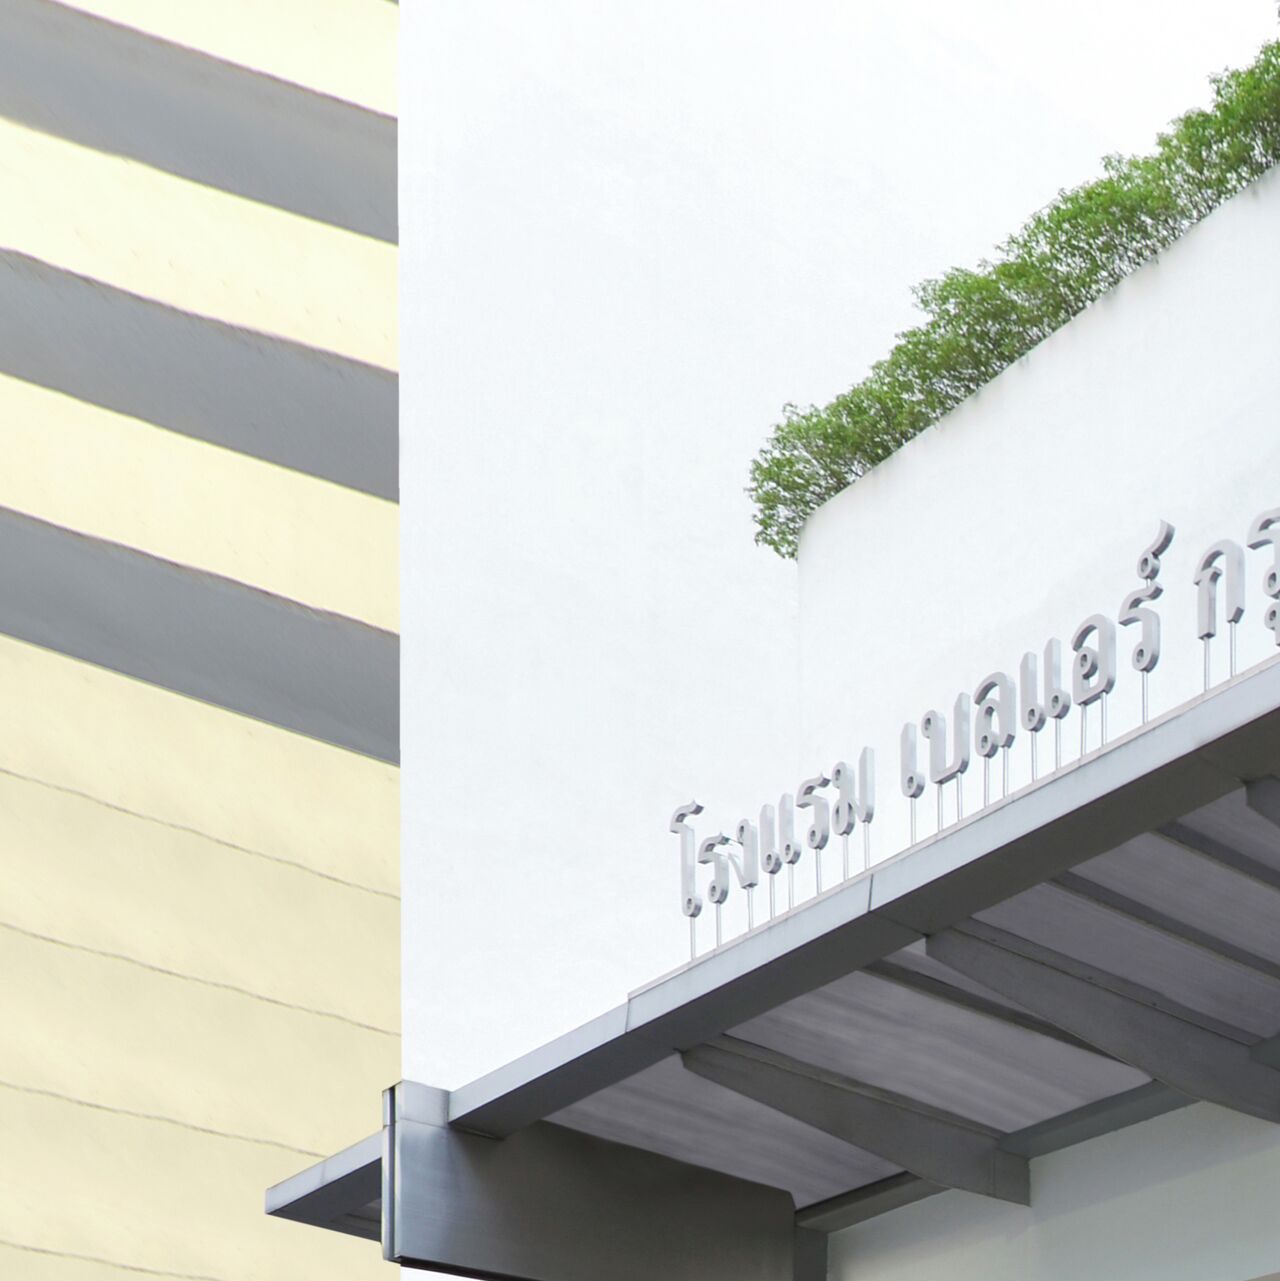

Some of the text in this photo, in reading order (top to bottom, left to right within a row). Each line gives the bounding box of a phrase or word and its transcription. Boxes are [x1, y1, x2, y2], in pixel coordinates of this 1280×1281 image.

[670, 746, 875, 917] โรงแรม
[899, 519, 1175, 798] เบลแอร์
